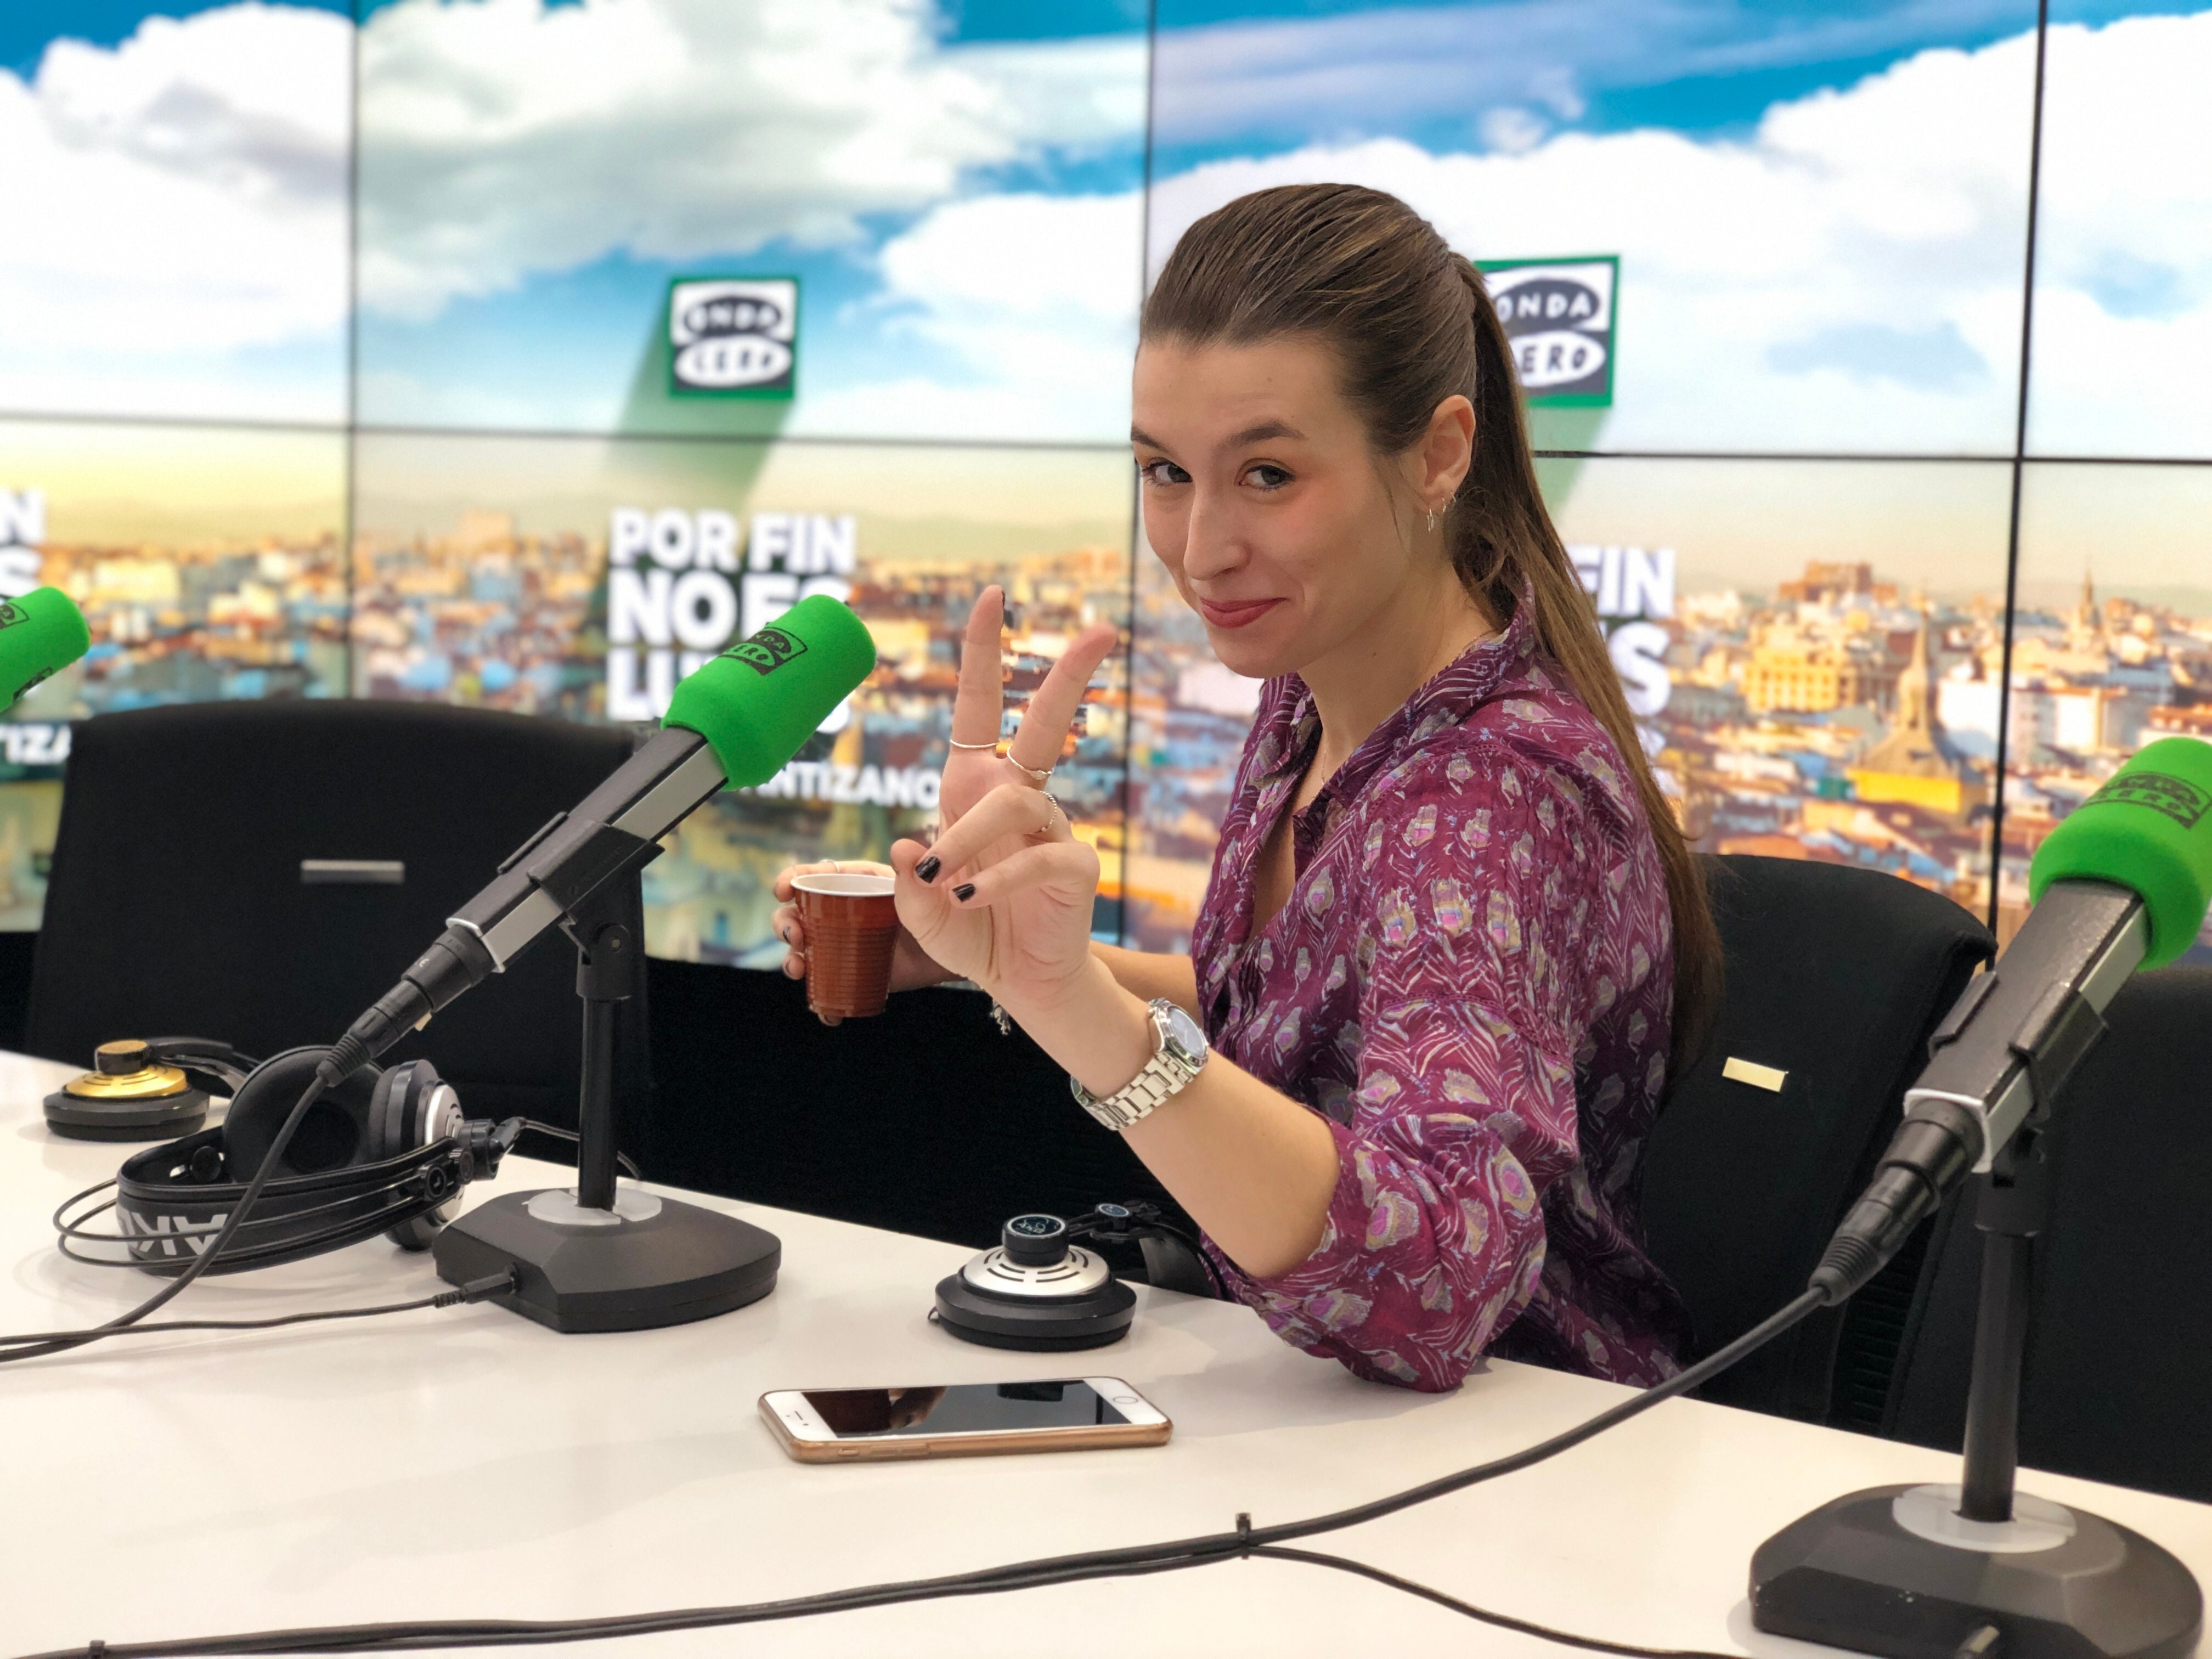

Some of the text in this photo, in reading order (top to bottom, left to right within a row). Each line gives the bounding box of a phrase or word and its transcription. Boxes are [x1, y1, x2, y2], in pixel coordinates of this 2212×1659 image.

[1497, 292, 1591, 323] ONDA
[1521, 346, 1588, 373] ERO
[611, 510, 854, 572] POR FIN
[609, 571, 851, 647] NO E
[732, 644, 769, 661] ERO
[1601, 620, 1672, 715] S
